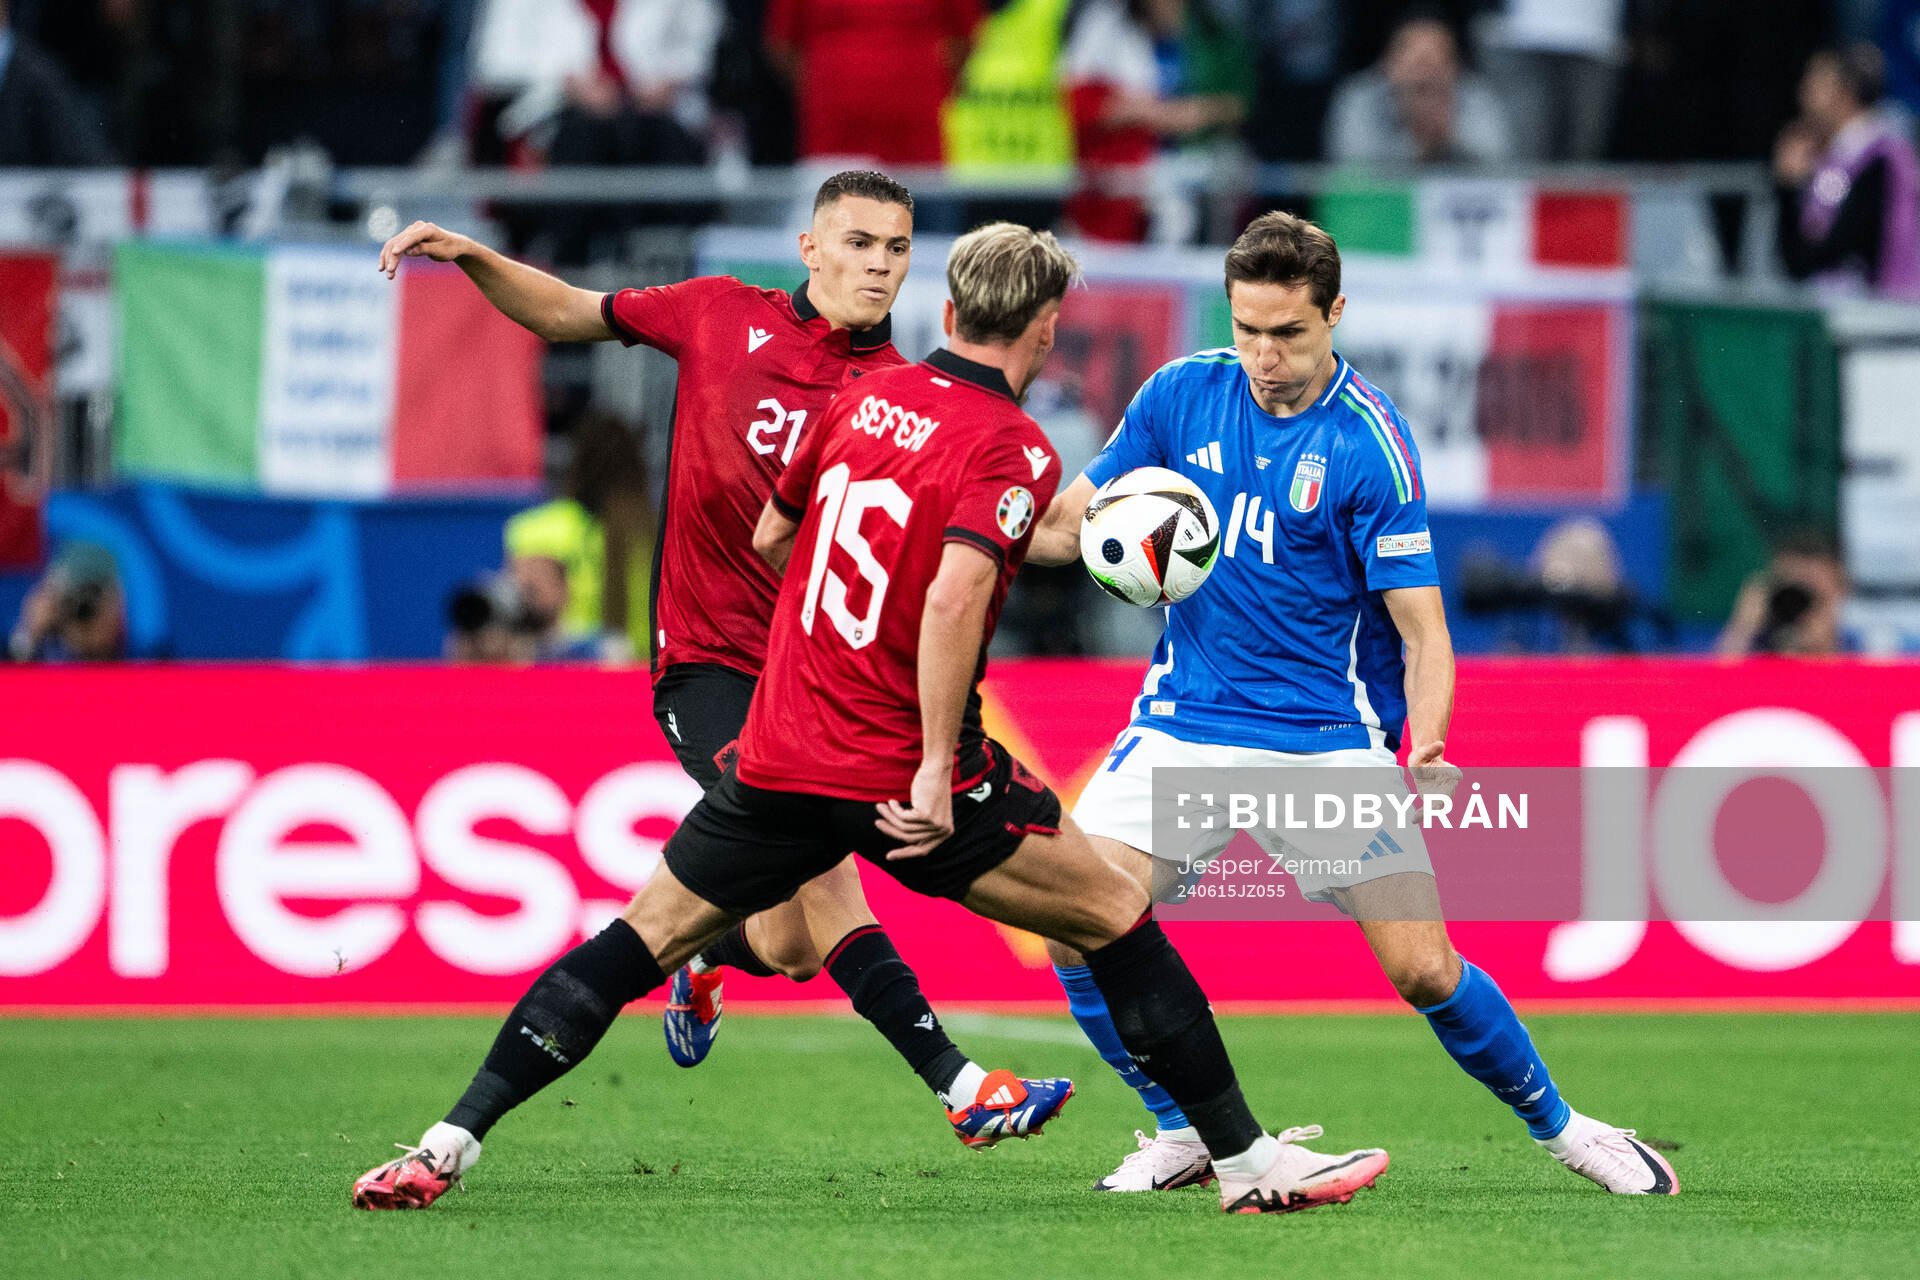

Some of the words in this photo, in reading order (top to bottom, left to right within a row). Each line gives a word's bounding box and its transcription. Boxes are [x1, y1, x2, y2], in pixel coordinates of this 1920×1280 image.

[746, 398, 808, 466] 21
[851, 395, 940, 452] SEFERI
[1297, 463, 1322, 478] ITALIA
[800, 462, 914, 650] 15
[1224, 492, 1275, 565] 14
